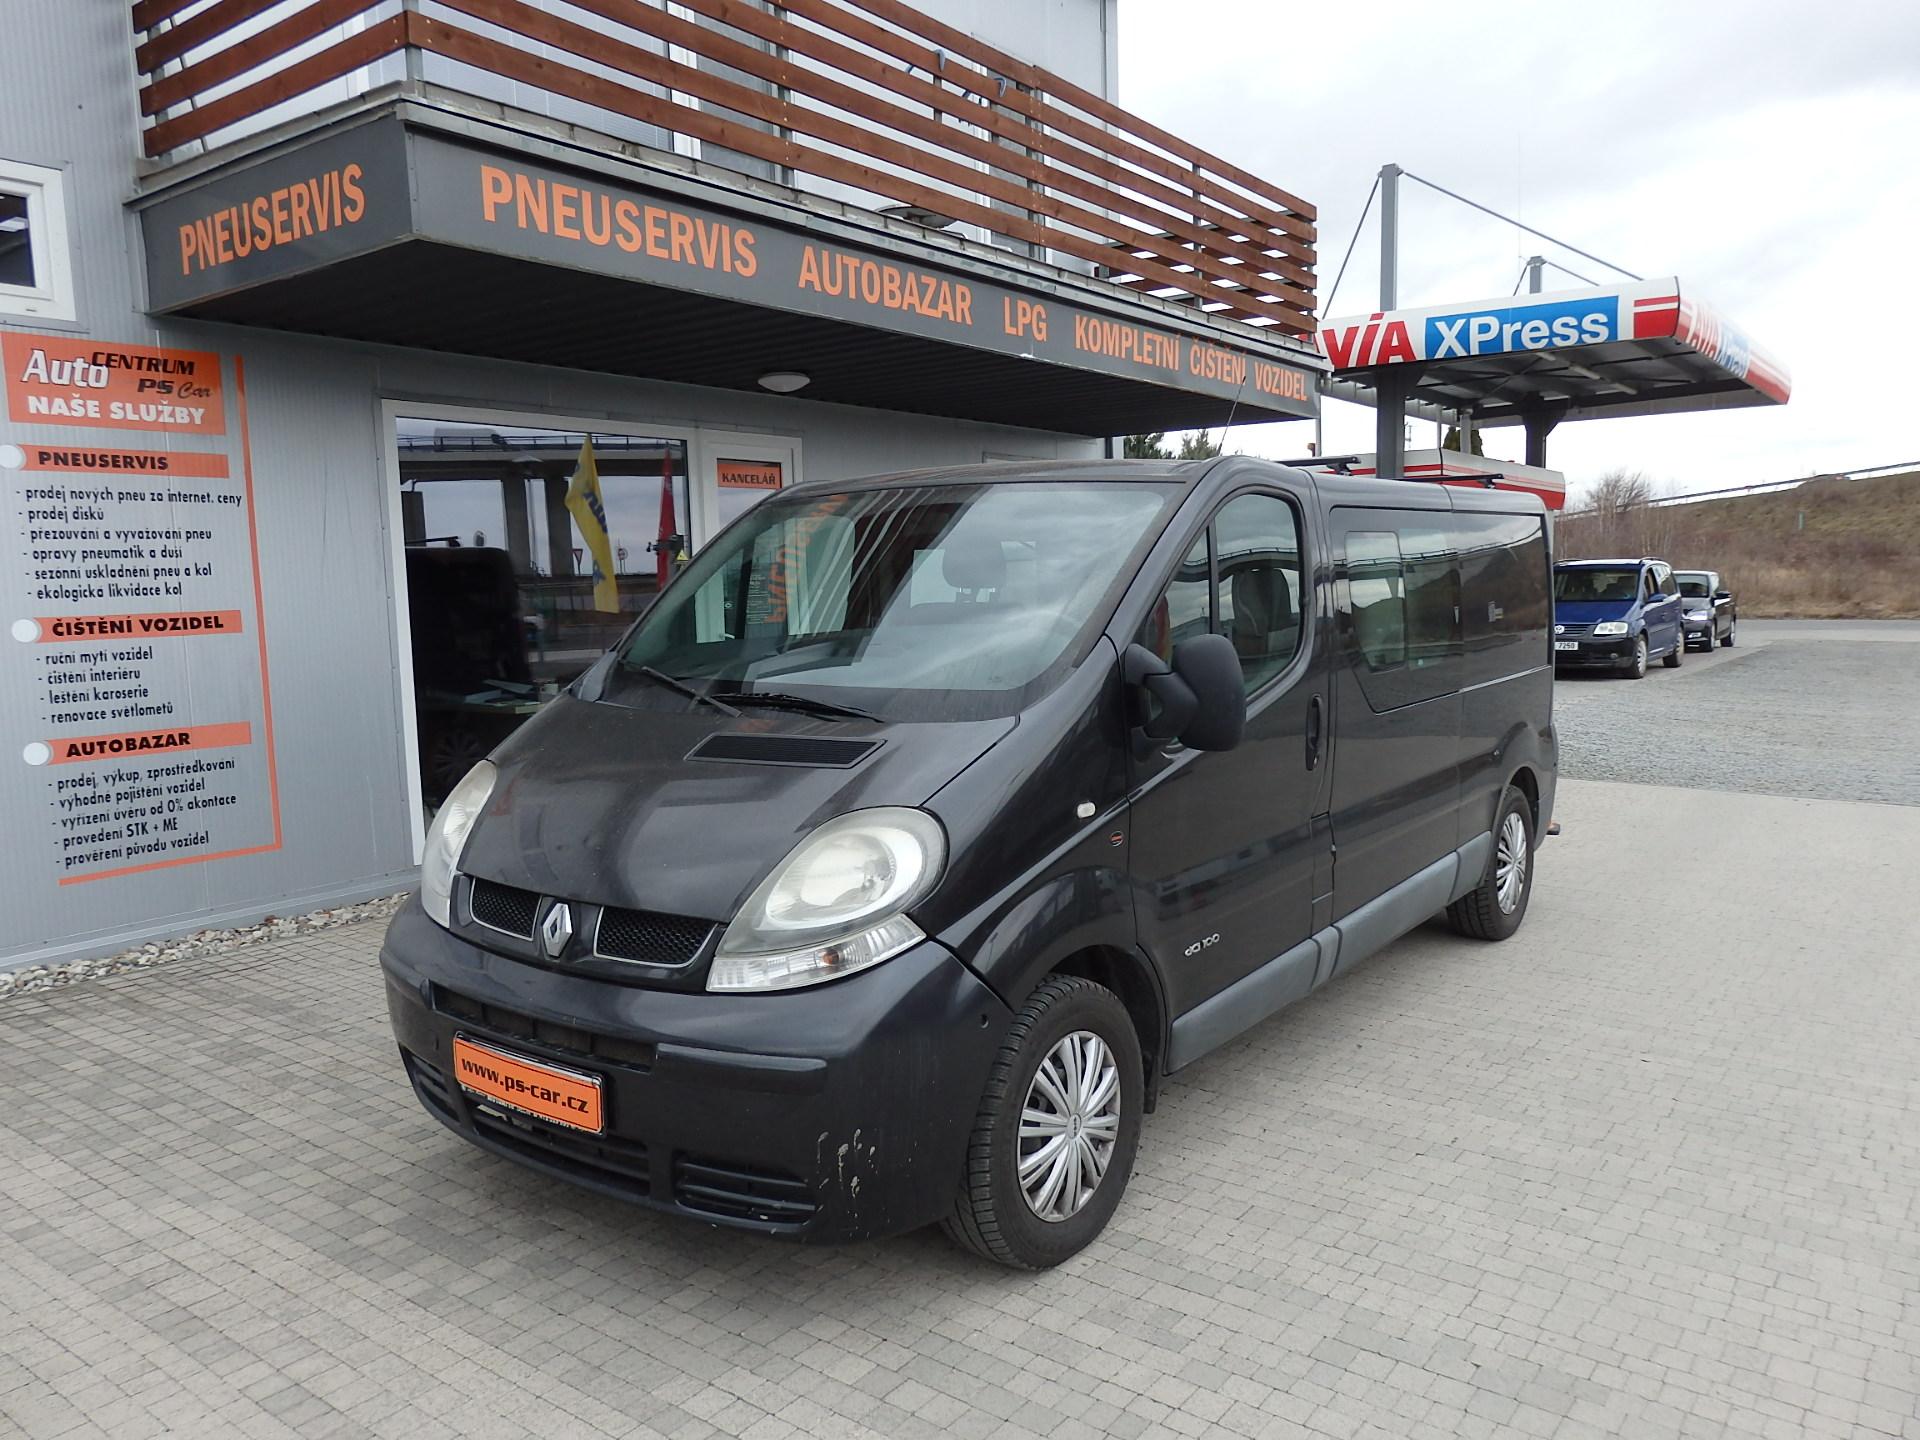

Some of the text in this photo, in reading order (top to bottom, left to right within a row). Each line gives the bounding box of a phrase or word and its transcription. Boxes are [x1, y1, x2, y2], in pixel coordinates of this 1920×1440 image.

[179, 163, 365, 276] PNEUSERVIS
[480, 164, 1308, 401] PNEUSERVIS AUTOBAZAR LPG KOMPLETNÍ ČIŠTĚNÍ VOZIDEL
[1433, 313, 1609, 360] XPress
[20, 348, 195, 389] Auto CENTRUM
[137, 378, 213, 399] PS Car
[27, 392, 206, 425] NAŠE SLUŽBY
[38, 451, 169, 470] PNEUSERVIS
[722, 471, 776, 485] KANCELÁŘ
[26, 484, 66, 503] prodej
[70, 486, 113, 503] nových
[118, 491, 146, 504] pneu
[150, 492, 163, 502] za
[217, 493, 242, 507] ceny
[28, 505, 68, 524] prodej
[103, 530, 111, 540] a
[186, 530, 212, 543] pneu
[33, 550, 76, 563] opravy
[82, 544, 144, 563] pneumatik
[149, 549, 156, 558] a
[153, 567, 180, 580] pneu
[184, 567, 191, 576] a
[195, 562, 212, 576] kol
[37, 581, 182, 602] ekologická likvidace kol
[52, 616, 224, 636] ČIŠTĚNÍ VOZIDEL
[46, 651, 75, 665] ruční
[112, 646, 153, 661] vozidel
[94, 684, 149, 701] karoserie
[51, 708, 107, 724] renovace
[66, 732, 190, 757] AUTOBAZAR
[167, 777, 205, 795] vozidel
[150, 800, 163, 815] od
[168, 798, 183, 813] 0%
[187, 795, 237, 810] akontace
[127, 821, 149, 838] STK
[126, 837, 167, 859] původu
[171, 830, 209, 849] vozidel
[461, 1058, 589, 1114] www.ps-car.cz
